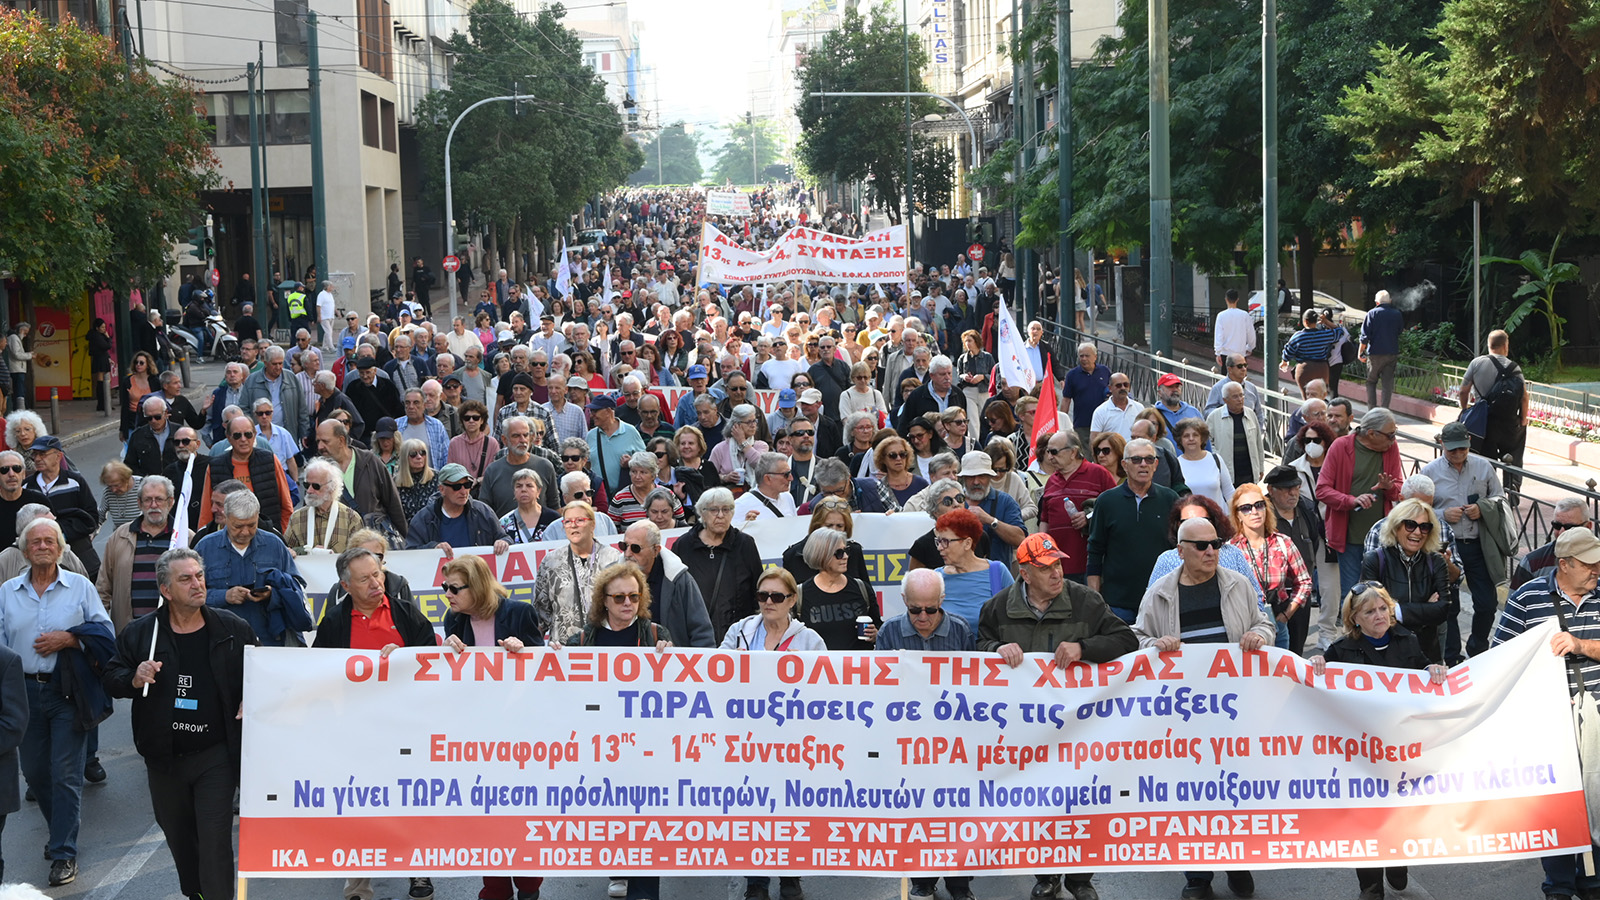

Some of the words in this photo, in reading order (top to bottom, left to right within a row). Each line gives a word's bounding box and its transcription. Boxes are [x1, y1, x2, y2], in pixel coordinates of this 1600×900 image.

[934, 0, 948, 63] LLAS
[797, 244, 904, 259] ΣΥΝΤΑΞΗΣ
[723, 274, 762, 282] ΣΩΜΑΤΕΙΟ
[872, 270, 906, 278] ΩΡΩΠΟΥ
[809, 602, 863, 623] GUESS
[345, 653, 390, 682] ΟΙ
[415, 652, 750, 683] ΣΥΝΤΑΞΙΟΥΧΟΙ
[777, 655, 900, 686] ΟΛΗΣ
[923, 656, 1010, 687] ΤΗΣ
[1033, 650, 1184, 688] ΧΩΡΑΣ
[1207, 649, 1473, 697] ΑΠΑΙΤΟΥΜΕ
[618, 690, 714, 719] ΤΩΡΑ
[725, 689, 875, 729] αυξήσεις
[885, 701, 922, 723] σε
[933, 690, 1008, 729] όλες
[1019, 703, 1066, 730] τις
[1076, 685, 1239, 724] συντάξεις
[430, 731, 580, 770] Επαναφορά
[725, 732, 846, 771] Σύνταξης
[897, 737, 968, 765] ΤΩΡΑ
[977, 735, 1050, 772] μέτρα
[1058, 728, 1203, 770] προστασίας
[1211, 737, 1251, 766] για
[1259, 735, 1304, 757] την
[1312, 732, 1423, 764] ακρίβεια
[293, 779, 325, 808] Να
[333, 775, 390, 815] γίνει
[397, 778, 463, 807] ΤΩΡΑ
[471, 774, 538, 814] άμεση
[546, 775, 669, 814] πρόσληψη:
[677, 775, 776, 814] Γιατρών,
[785, 778, 926, 809] Νοσηλευτών
[933, 787, 971, 808] στα
[978, 774, 1112, 814] Νοσοκομεία
[1138, 775, 1169, 803] Να
[1175, 769, 1281, 809] ανοίξουν
[1288, 767, 1341, 800] αυτά
[1348, 777, 1390, 799] που
[1397, 771, 1465, 798] έχουν
[1474, 756, 1557, 792] κλείσει
[272, 849, 309, 867] ΙΚΑ
[331, 848, 387, 867] ΟΑΕΕ
[409, 847, 517, 867] ΔΗΜΟΣΙΟΥ
[539, 848, 593, 866] ΠΟΣΕ
[599, 848, 653, 866] ΟΑΕΕ
[675, 848, 727, 866] ΕΛΤΑ
[751, 848, 790, 866] ΟΣΕ
[812, 848, 851, 867] ΠΕΣ
[857, 848, 898, 867] ΝΑΤ
[920, 848, 958, 867] ΠΣΣ
[964, 846, 1082, 866] ΔΙΚΗΓΟΡΩΝ
[1104, 842, 1172, 862] ΠΟΣΕΑ
[1177, 841, 1245, 861] ΕΤΕΑΠ
[1268, 840, 1379, 859] ΕΣΤΑΜΕΔΕ
[1402, 837, 1449, 857] ΟΤΑ
[1467, 828, 1559, 855] ΠΕΣΜΕΝ
[525, 820, 811, 842] ΣΥΝΕΡΓΑΖΟΜΕΝΕΣ
[827, 819, 1091, 844] ΣΥΝΤΑΞΙΟΥΧΙΚΕΣ
[1108, 813, 1300, 838] ΟΡΓΑΝΩΣΕΙΣ
